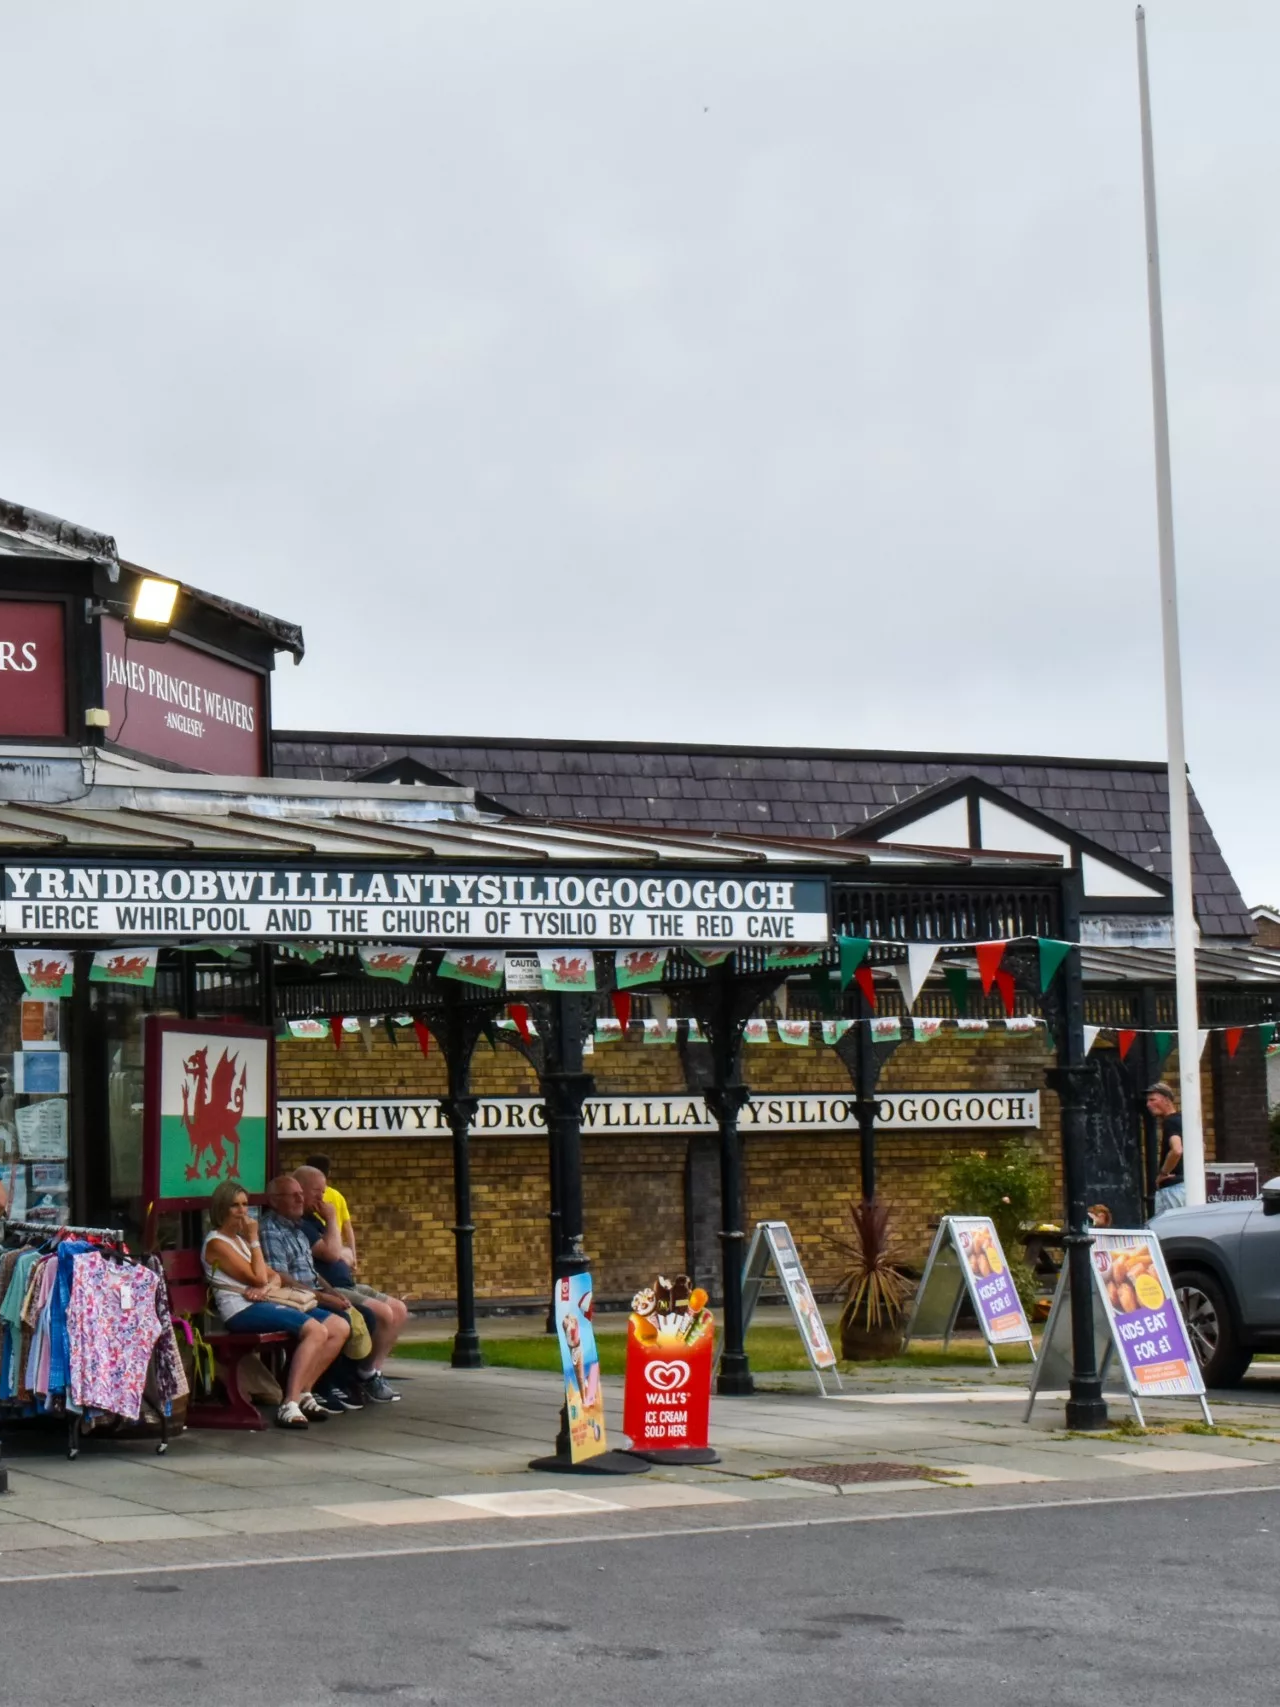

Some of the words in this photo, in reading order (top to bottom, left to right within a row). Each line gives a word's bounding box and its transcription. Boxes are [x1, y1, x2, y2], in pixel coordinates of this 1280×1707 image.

[105, 652, 145, 694] JAMES
[148, 667, 202, 713] PRINGLE
[203, 688, 255, 733] WEAVERS
[23, 905, 98, 930] FIERCE
[116, 906, 249, 932] WHIRLPOOL
[266, 908, 311, 932] AND
[328, 909, 367, 933] THE
[383, 910, 469, 935] CHURCH
[486, 911, 510, 935] OF
[521, 911, 596, 936] TYSILIO
[610, 912, 633, 937] BY
[648, 913, 682, 938] THE
[697, 913, 732, 938] RED
[748, 914, 795, 939] CAVE
[1119, 1320, 1145, 1342] KIDS
[1143, 1312, 1168, 1333] EAT
[1133, 1340, 1159, 1361] FOR
[644, 1411, 658, 1424] ICE
[659, 1410, 688, 1423] CREAM
[644, 1425, 666, 1438] SOLD
[667, 1424, 688, 1437] HERE
